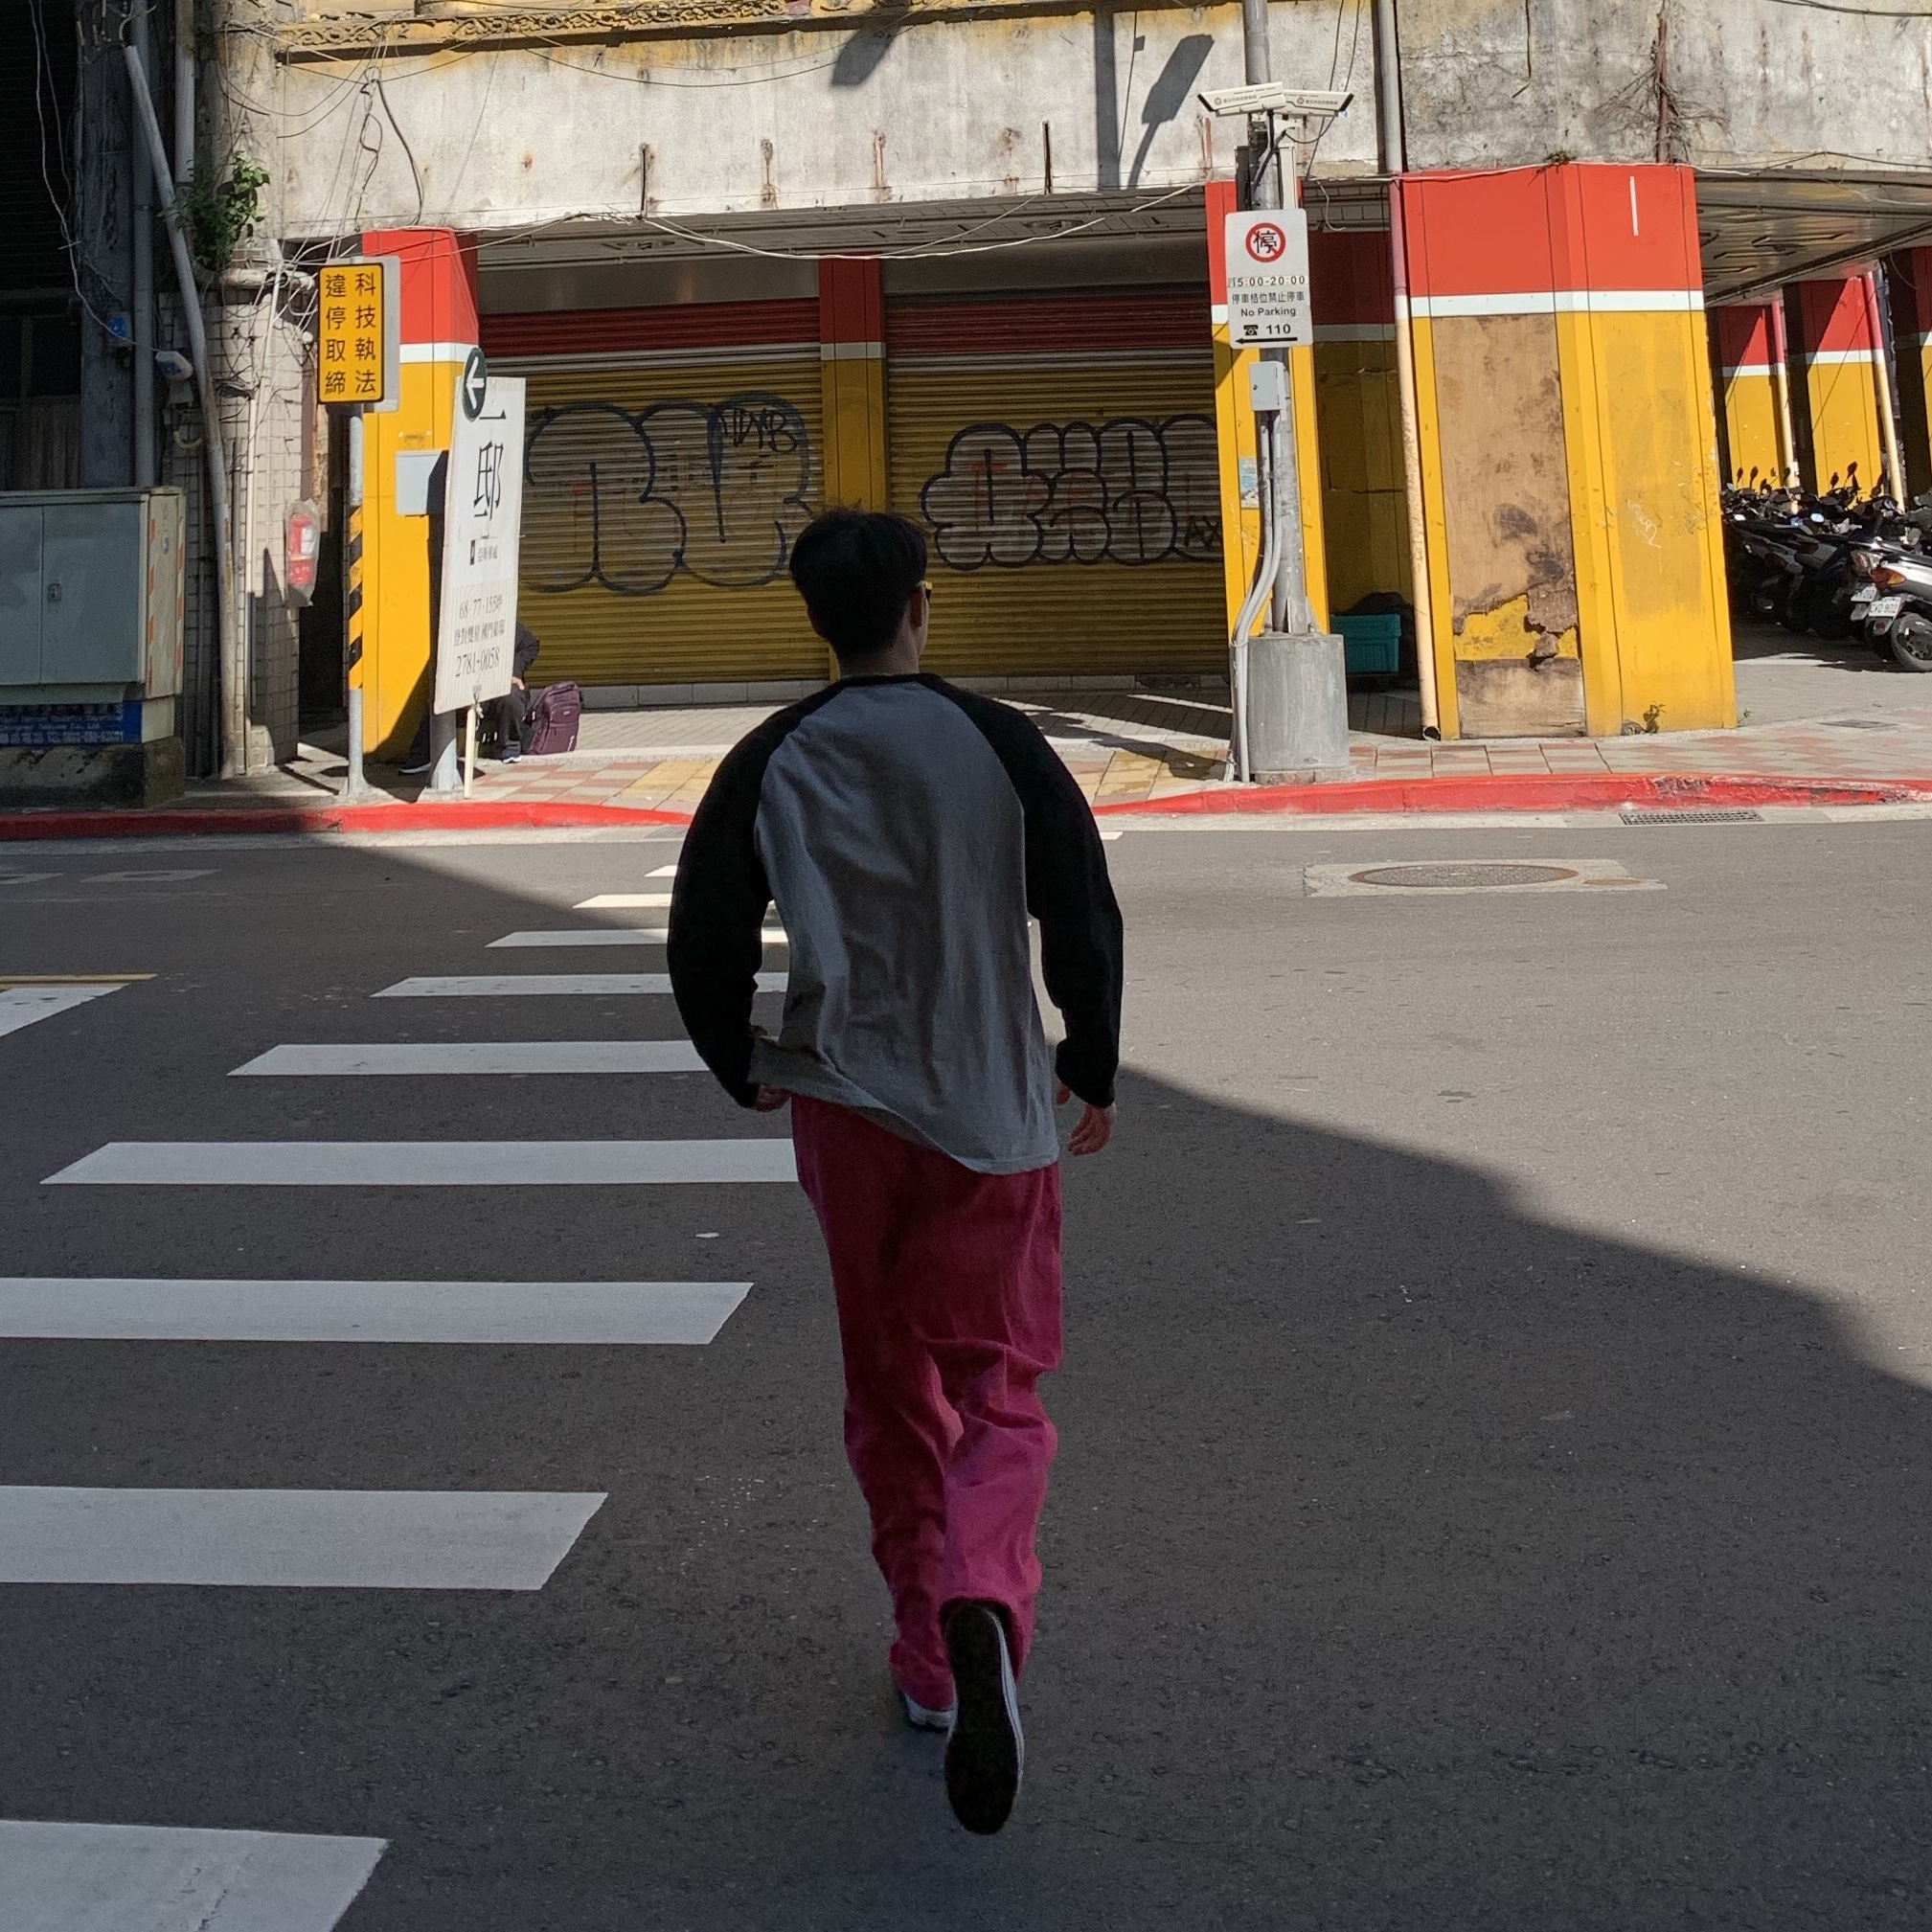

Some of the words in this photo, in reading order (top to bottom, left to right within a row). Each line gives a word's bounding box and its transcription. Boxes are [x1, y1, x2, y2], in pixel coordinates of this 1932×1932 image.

[1232, 276, 1306, 287] 15:00-20:00
[1232, 291, 1305, 305] 停車格位禁止停車
[1240, 308, 1255, 317] No
[1258, 307, 1296, 317] Parking
[325, 274, 347, 395] 違停取締
[355, 272, 376, 394] 科技執法
[1266, 324, 1291, 334] 110
[456, 647, 500, 677] 2781-0058
